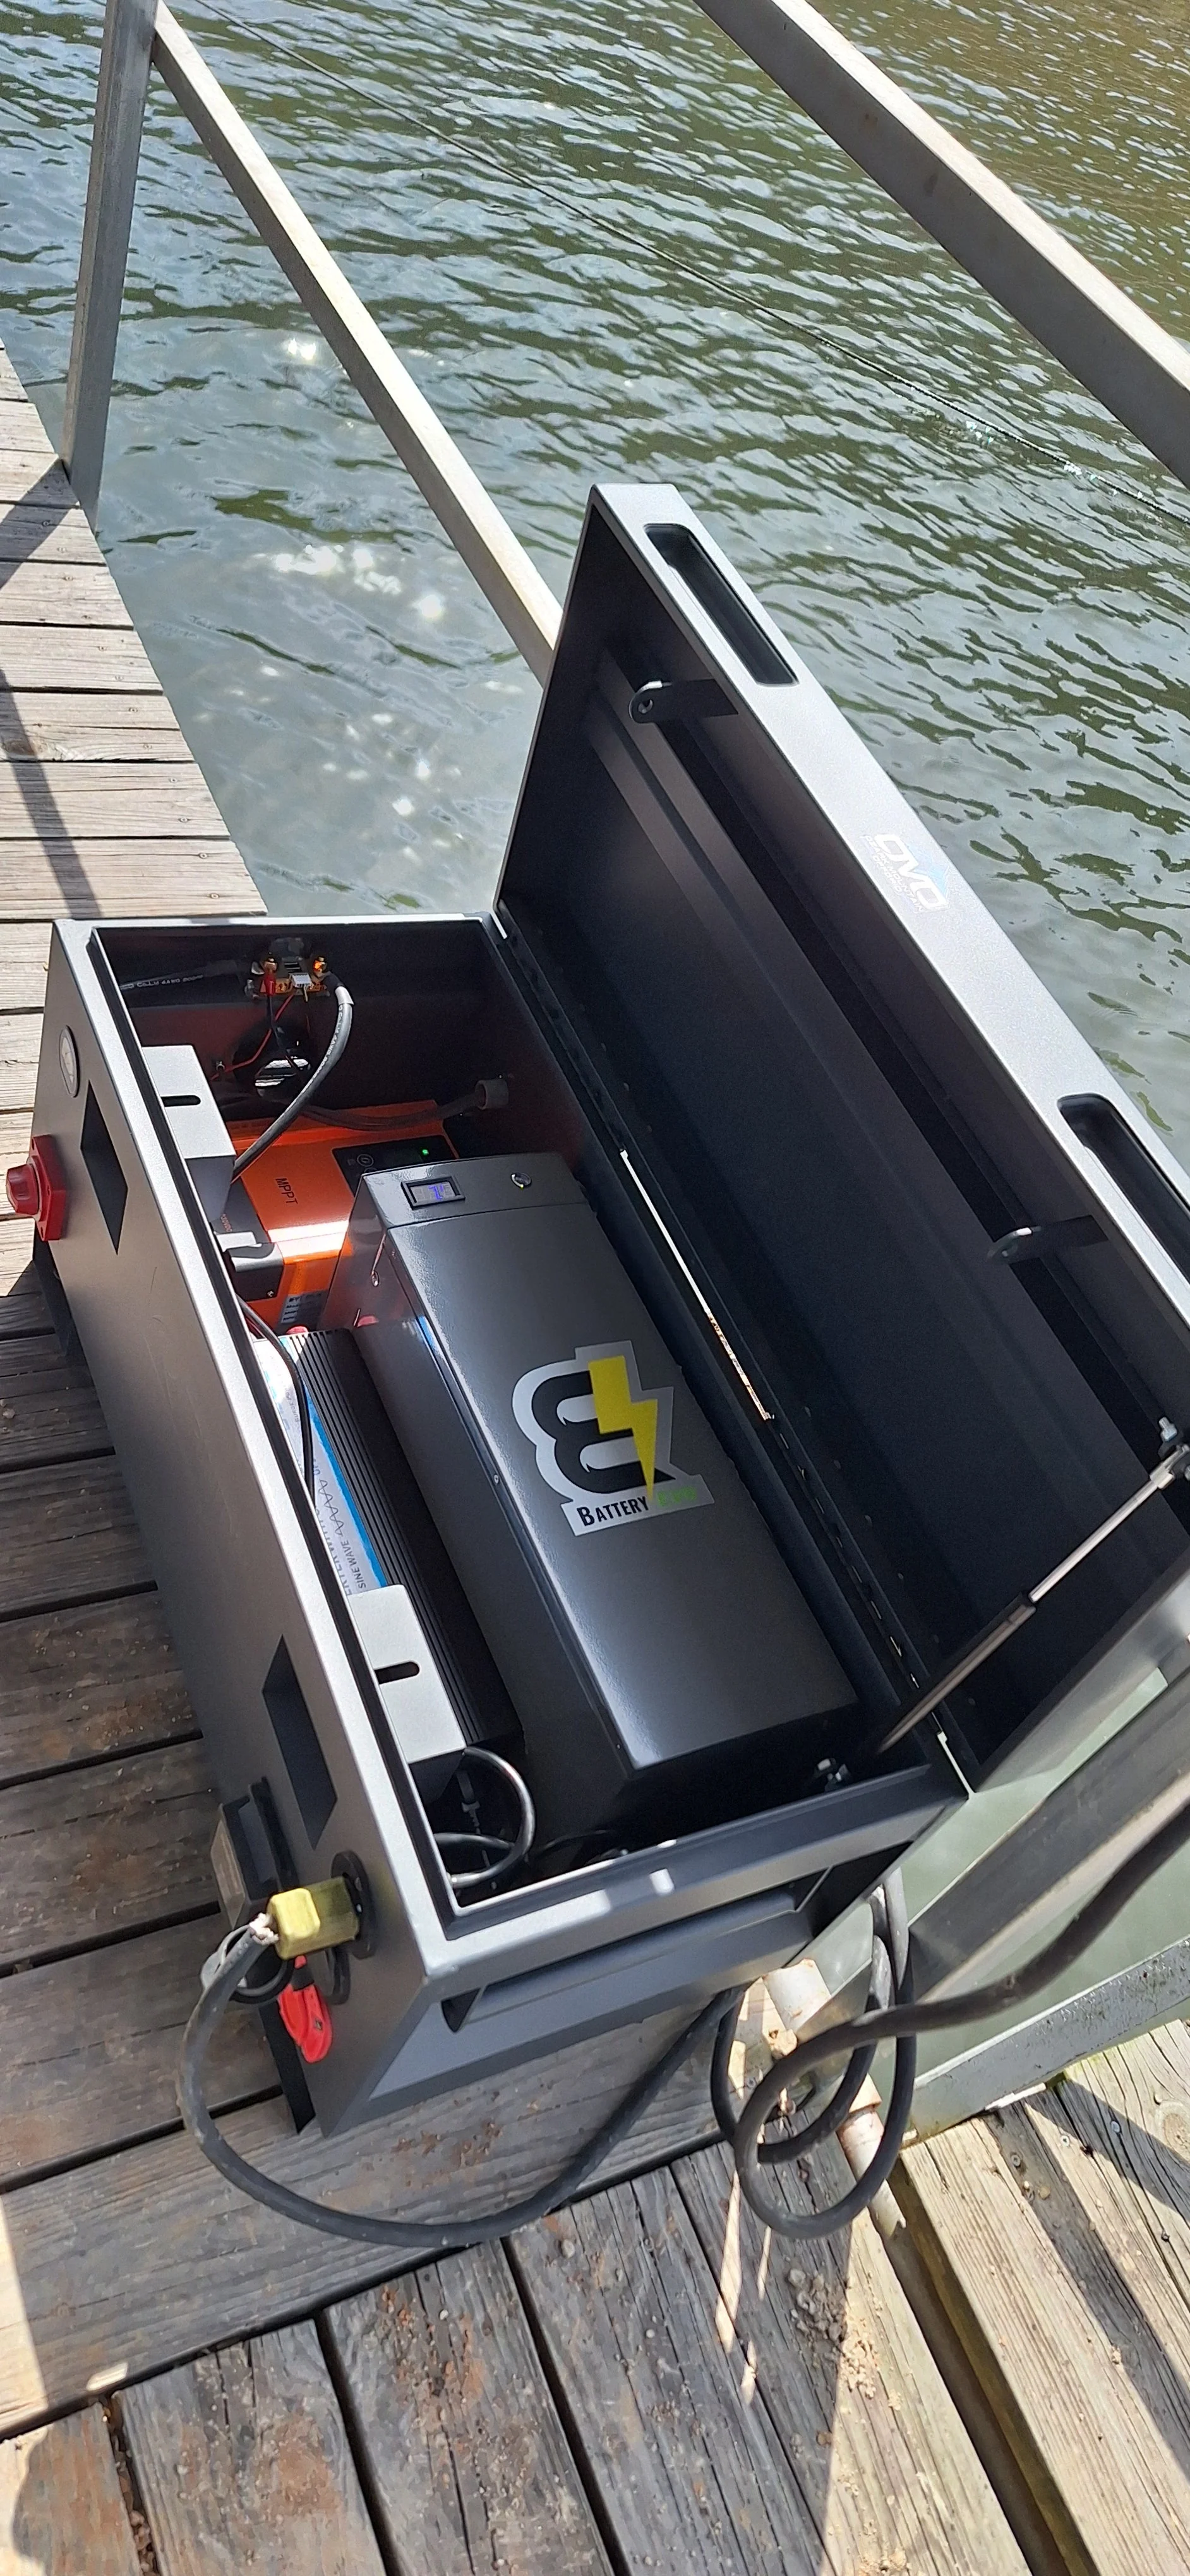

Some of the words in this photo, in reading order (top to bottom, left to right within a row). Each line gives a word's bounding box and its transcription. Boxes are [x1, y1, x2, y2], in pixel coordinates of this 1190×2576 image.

[275, 1178, 298, 1205] MPPT
[340, 1540, 361, 1568] WAVE
[352, 1568, 366, 1589] SINE
